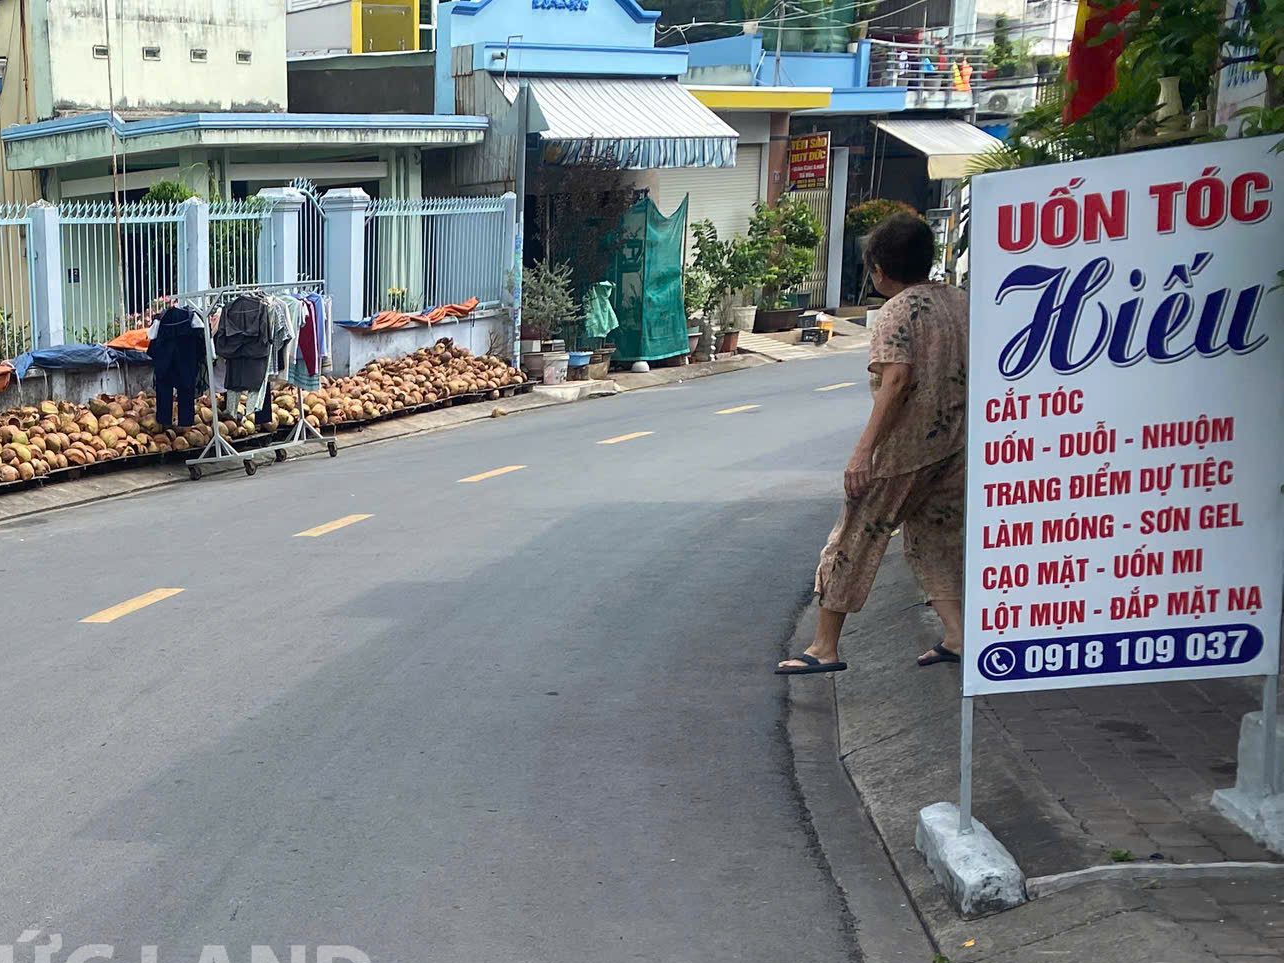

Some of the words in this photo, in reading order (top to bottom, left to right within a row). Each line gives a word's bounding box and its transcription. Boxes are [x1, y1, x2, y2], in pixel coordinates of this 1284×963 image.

[997, 177, 1128, 254] UỐN
[1149, 166, 1273, 234] TÓC
[995, 251, 1269, 381] Hiếu
[985, 387, 1031, 423] CẮT
[1038, 385, 1084, 418] TÓC
[984, 430, 1034, 466] UỐN
[1059, 420, 1117, 458] DUỖI
[1142, 414, 1235, 450] NHUỘM
[983, 477, 1062, 508] TRANG
[1069, 462, 1132, 500] ĐIỂM
[1139, 463, 1176, 497] DỰ
[1180, 456, 1234, 492] TIỆC
[982, 519, 1034, 550] LÀM
[1041, 512, 1115, 544] MÓNG
[1140, 504, 1192, 535] SƠN
[1199, 502, 1244, 530] GEL
[982, 563, 1029, 594] CẠO
[1037, 554, 1090, 589] MẶT
[1114, 544, 1165, 579] UỐN
[1172, 548, 1203, 574] MI
[981, 602, 1023, 636] LỘT
[1030, 600, 1086, 630] MỤN
[1110, 586, 1160, 621] ĐẮP
[1167, 585, 1220, 620] MẶT
[1228, 586, 1263, 616] NẠ
[1024, 640, 1104, 673] 0918
[1116, 635, 1175, 666] 109
[1185, 630, 1249, 661] 037
